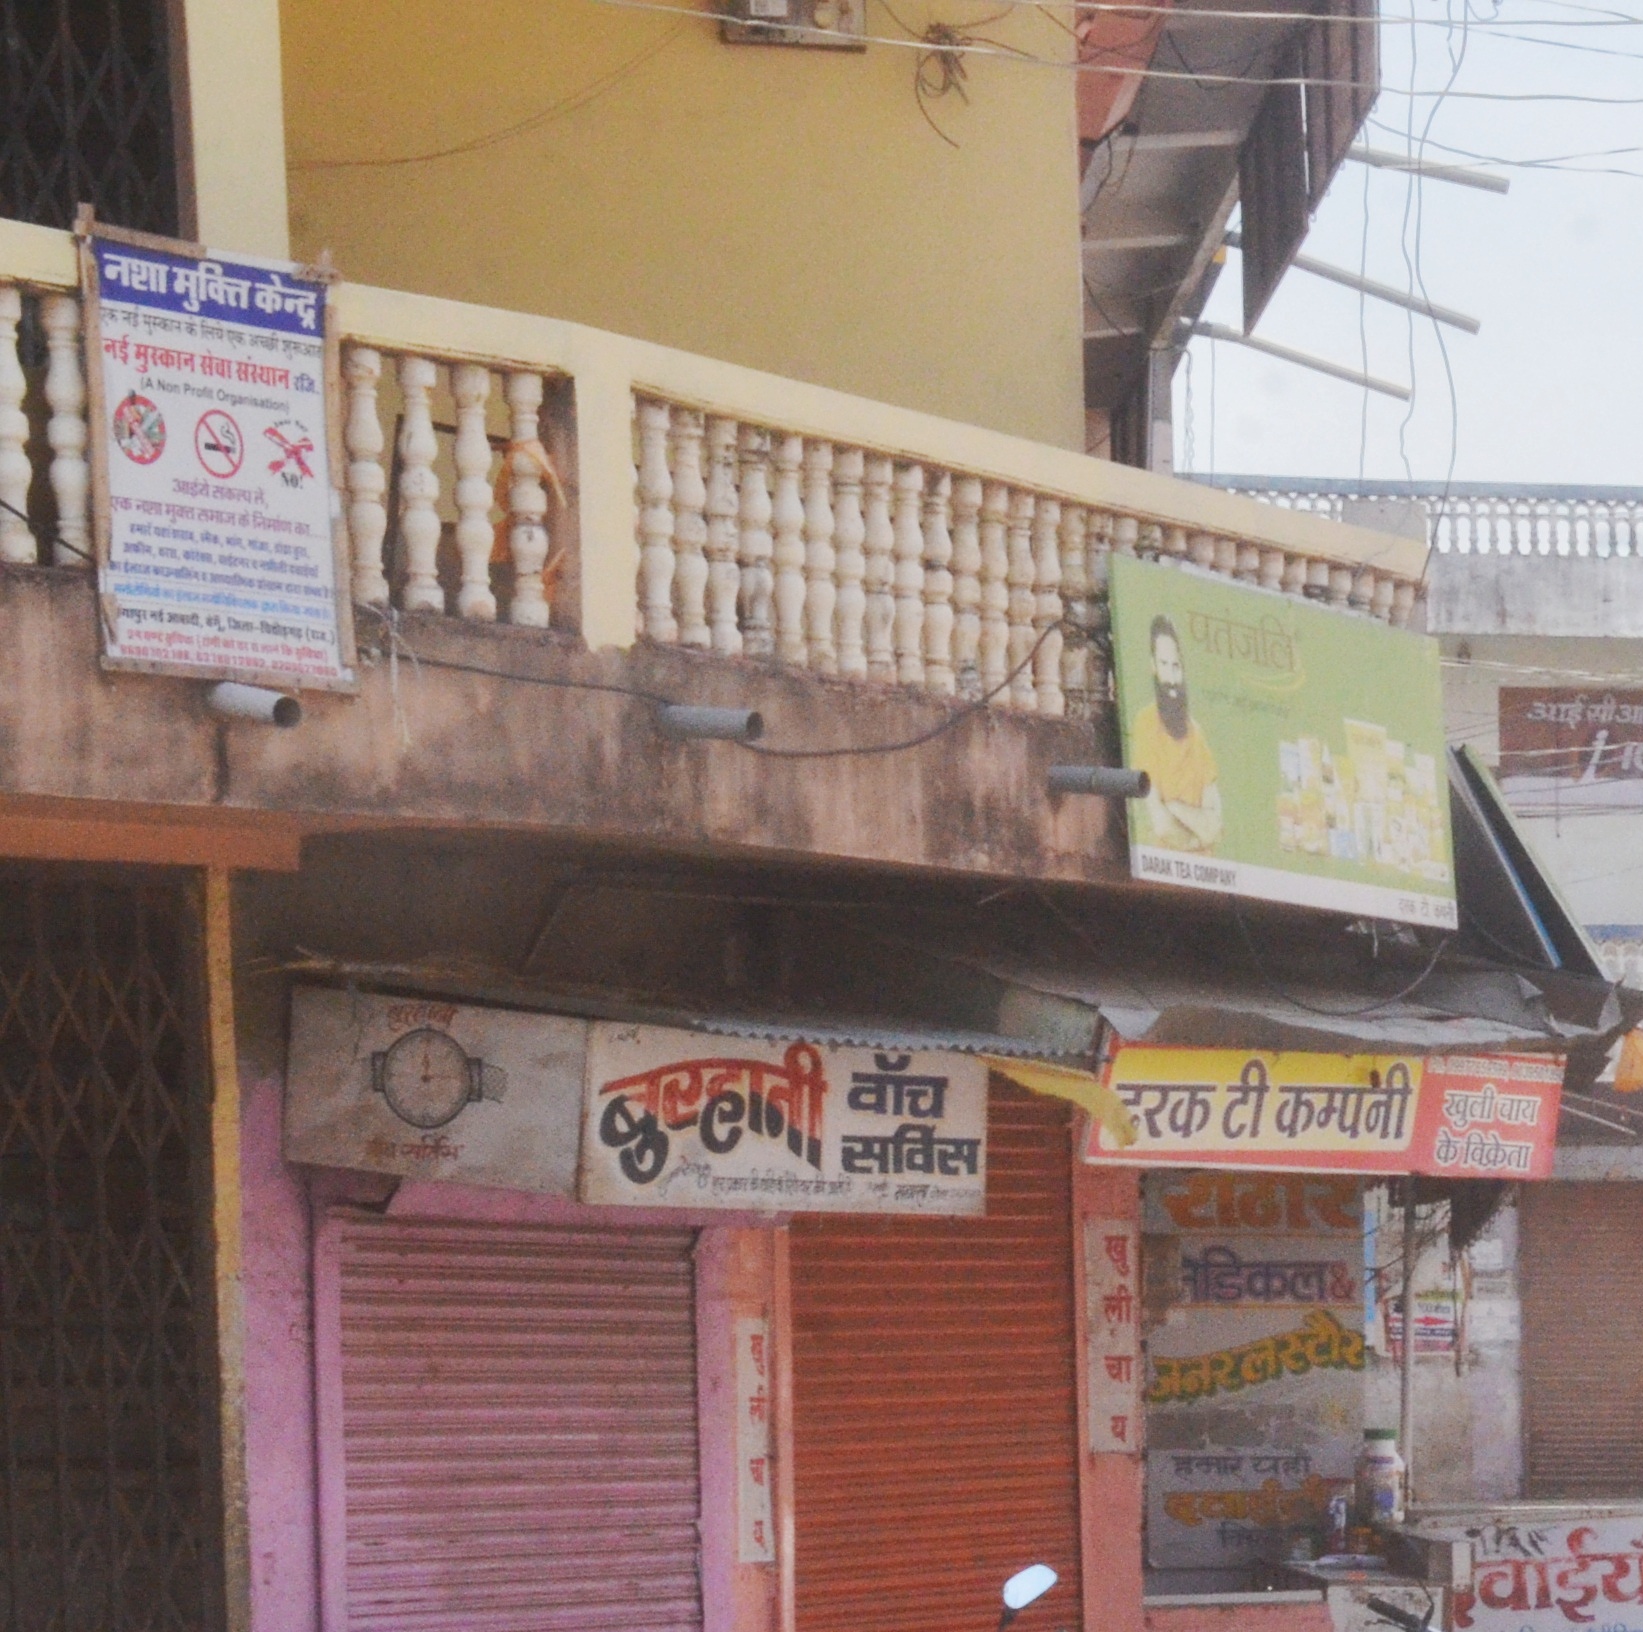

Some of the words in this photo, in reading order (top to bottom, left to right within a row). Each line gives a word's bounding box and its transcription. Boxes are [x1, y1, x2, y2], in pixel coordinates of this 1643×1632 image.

[103, 252, 170, 294] नशा
[172, 261, 251, 312] मुक्ति
[254, 273, 318, 330] केन्द्र
[102, 334, 130, 365] नई
[133, 342, 195, 374] मुस्कान
[199, 350, 232, 379] सेवा
[235, 356, 290, 390] संस्थान
[156, 379, 180, 394] Non
[183, 383, 214, 399] Profit
[1140, 853, 1173, 876] DARAK
[1174, 859, 1193, 880] TEA
[1194, 861, 1237, 887] COMPANY
[848, 1054, 949, 1120] वॉच
[1222, 1058, 1271, 1140] टी
[1275, 1060, 1413, 1141] कम्पनी
[1445, 1086, 1495, 1128] खुली
[1499, 1098, 1541, 1123] चाय
[841, 1127, 981, 1176] सर्विस
[1436, 1130, 1461, 1163] के
[1464, 1132, 1532, 1169] विक्रेता
